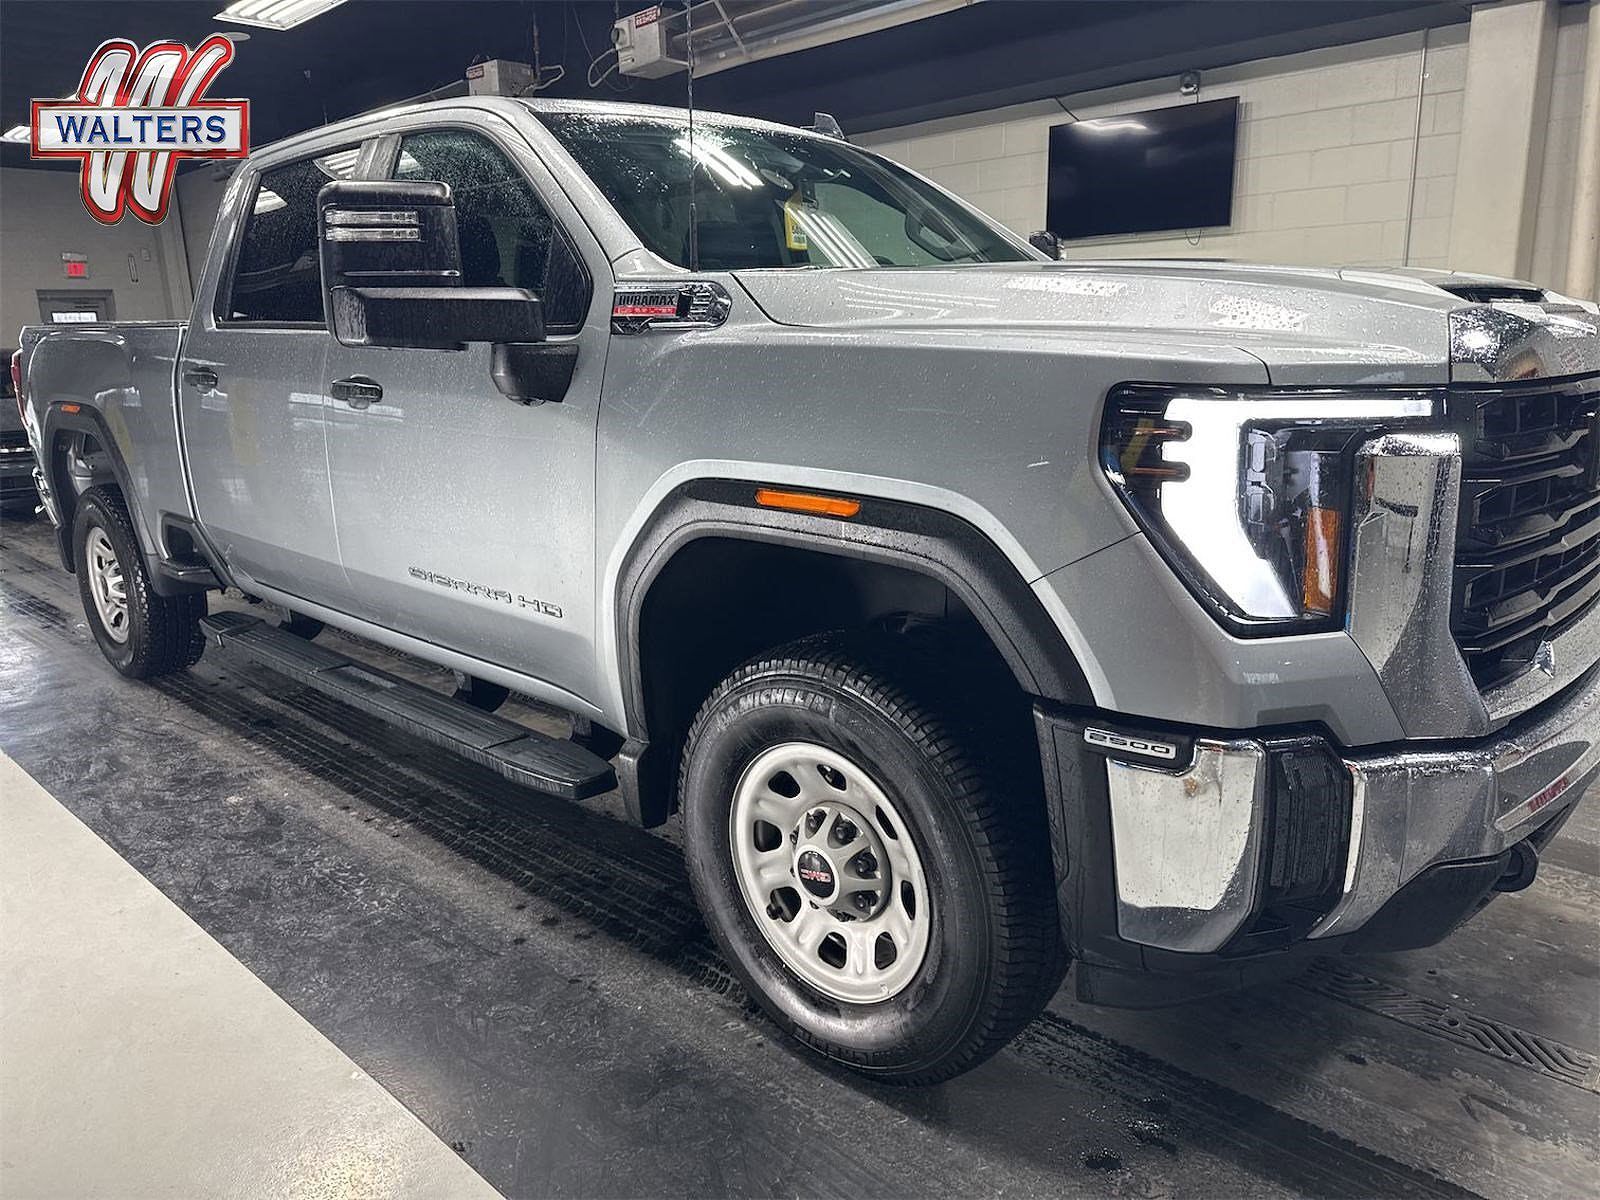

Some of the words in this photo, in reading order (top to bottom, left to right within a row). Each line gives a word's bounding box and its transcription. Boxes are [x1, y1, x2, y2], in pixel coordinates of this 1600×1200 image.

[618, 294, 677, 306] DURAMAX
[408, 566, 513, 604] SIERRA
[517, 594, 564, 619] HD
[739, 687, 832, 719] MICHELIN
